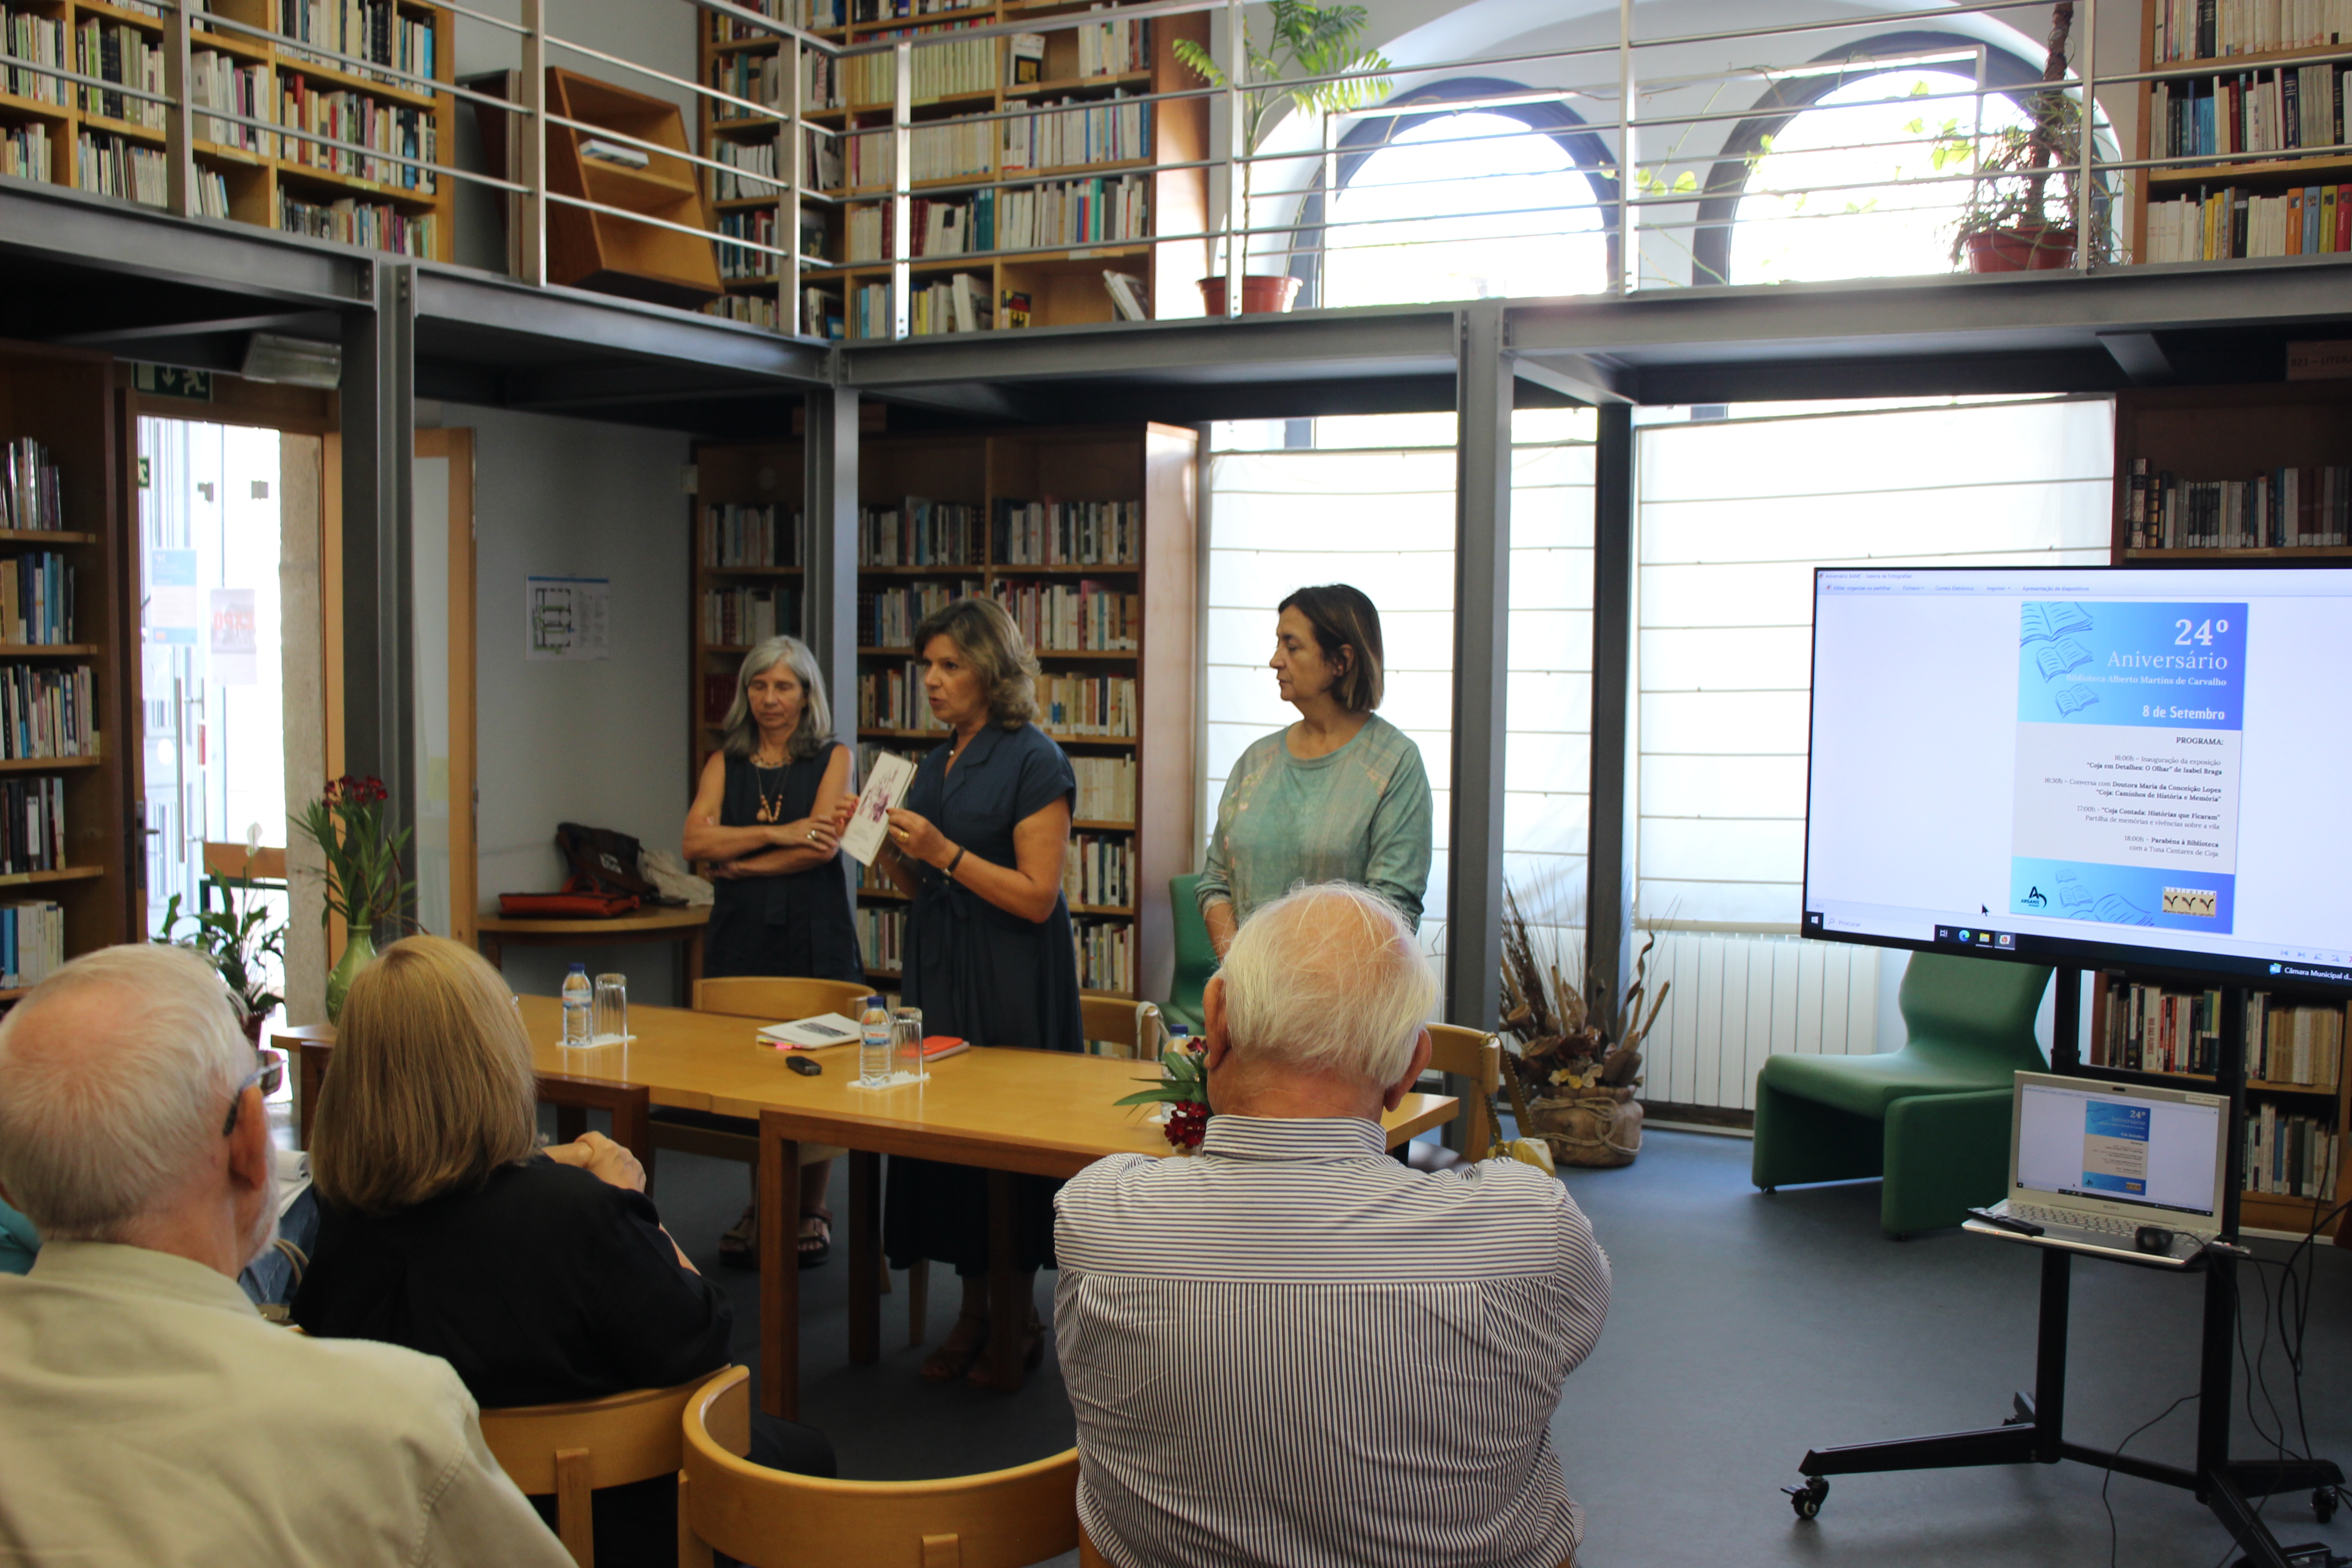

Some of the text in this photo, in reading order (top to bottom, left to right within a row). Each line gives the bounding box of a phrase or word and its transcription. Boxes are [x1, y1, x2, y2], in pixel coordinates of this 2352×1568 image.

[2291, 358, 2308, 367] 821
[2174, 619, 2229, 646] 24º
[2107, 651, 2228, 670] Aniversário
[2066, 674, 2227, 686] Biblioteca Alberto Martins de Carvalho
[2142, 705, 2225, 720] 8 de Setembro
[2176, 736, 2224, 745] PROGRAMA:
[2141, 756, 2179, 765] Inauguração
[2189, 758, 2221, 767] exposição
[2115, 790, 2146, 798] Caminhos
[2168, 784, 2201, 794] Conceição
[2202, 786, 2222, 794] Lopes
[2119, 808, 2147, 816] Contada:
[2147, 809, 2177, 818] Histórias
[2151, 837, 2180, 845] Parabéns
[2186, 840, 2219, 848] Biblioteca
[2148, 845, 2165, 853] Tuna
[2166, 847, 2194, 855] Cantares
[2204, 850, 2219, 859] Coja
[2284, 966, 2309, 976] Câmara
[2310, 969, 2342, 980] Municipal
